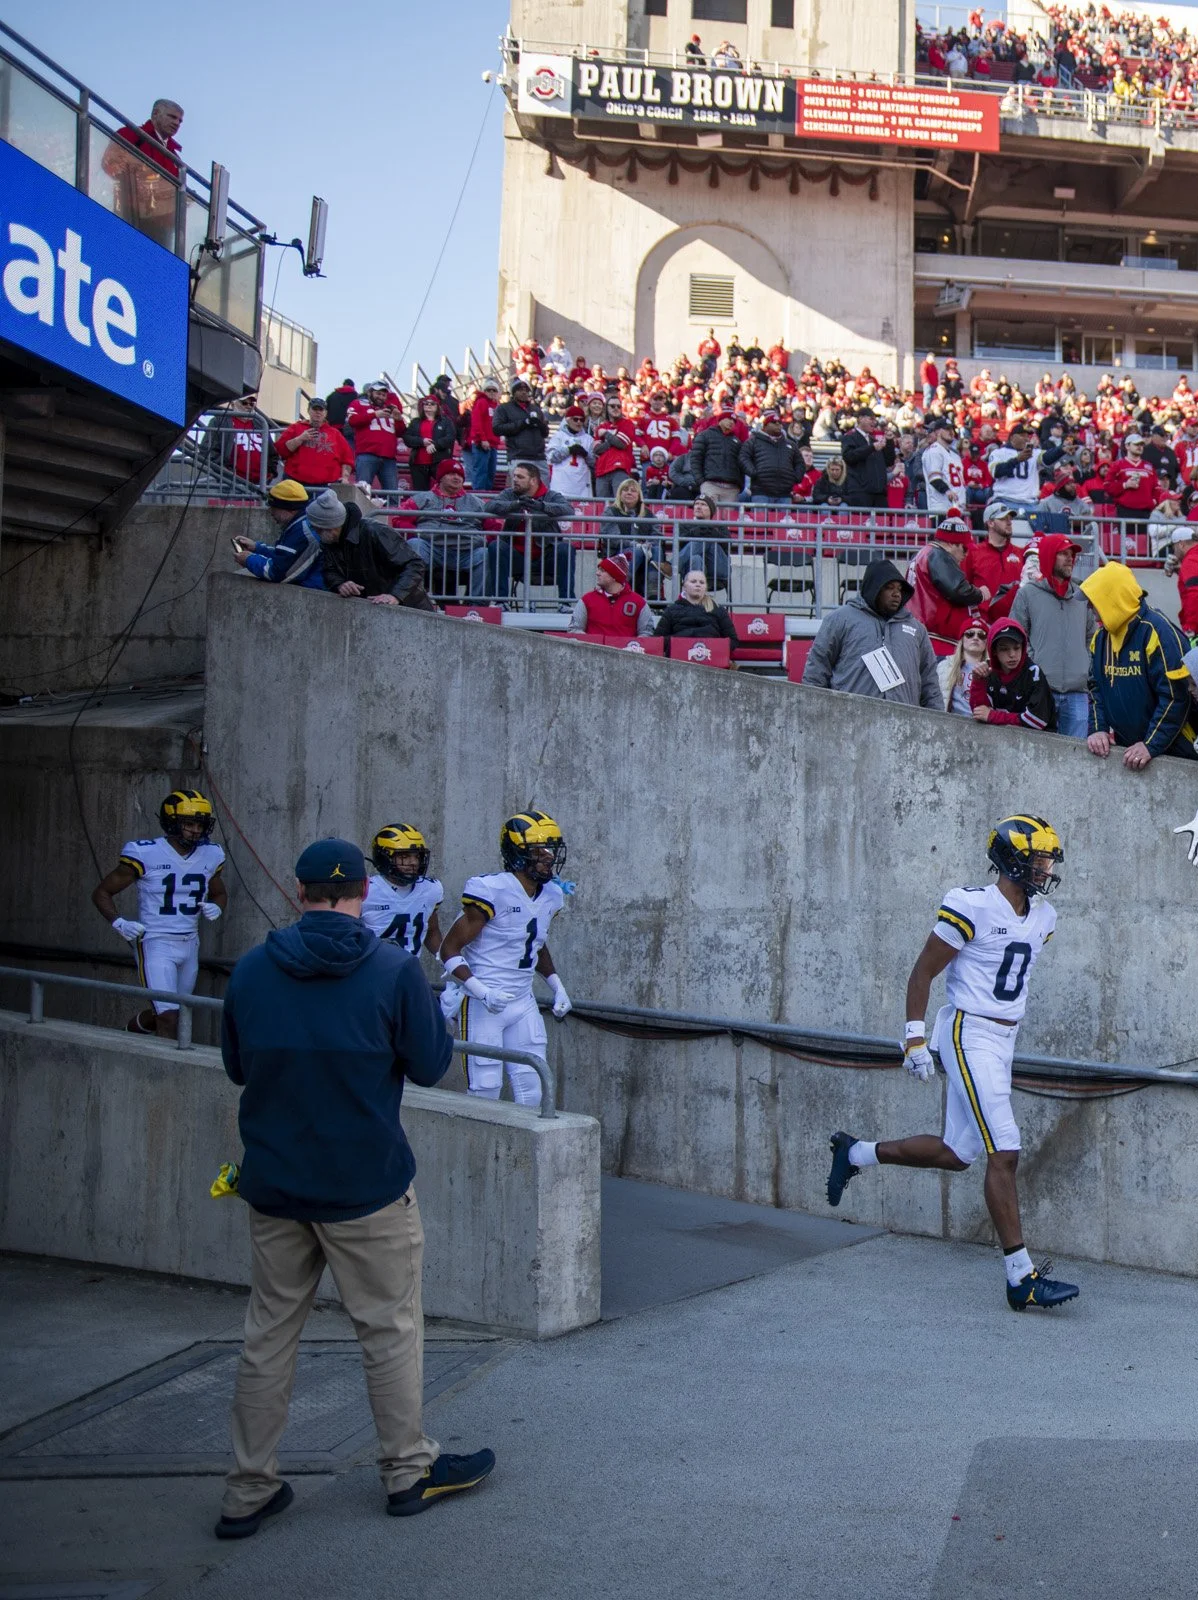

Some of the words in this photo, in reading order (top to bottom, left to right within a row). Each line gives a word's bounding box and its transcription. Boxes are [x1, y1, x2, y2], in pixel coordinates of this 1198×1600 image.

[578, 62, 661, 102] PAUL
[671, 71, 785, 113] BROWN
[646, 105, 683, 120] COACH
[646, 419, 671, 439] 45
[1129, 650, 1140, 661] M
[159, 872, 206, 916] 13
[379, 912, 423, 956] 41
[518, 917, 538, 969] 1
[993, 941, 1033, 1002] 0
